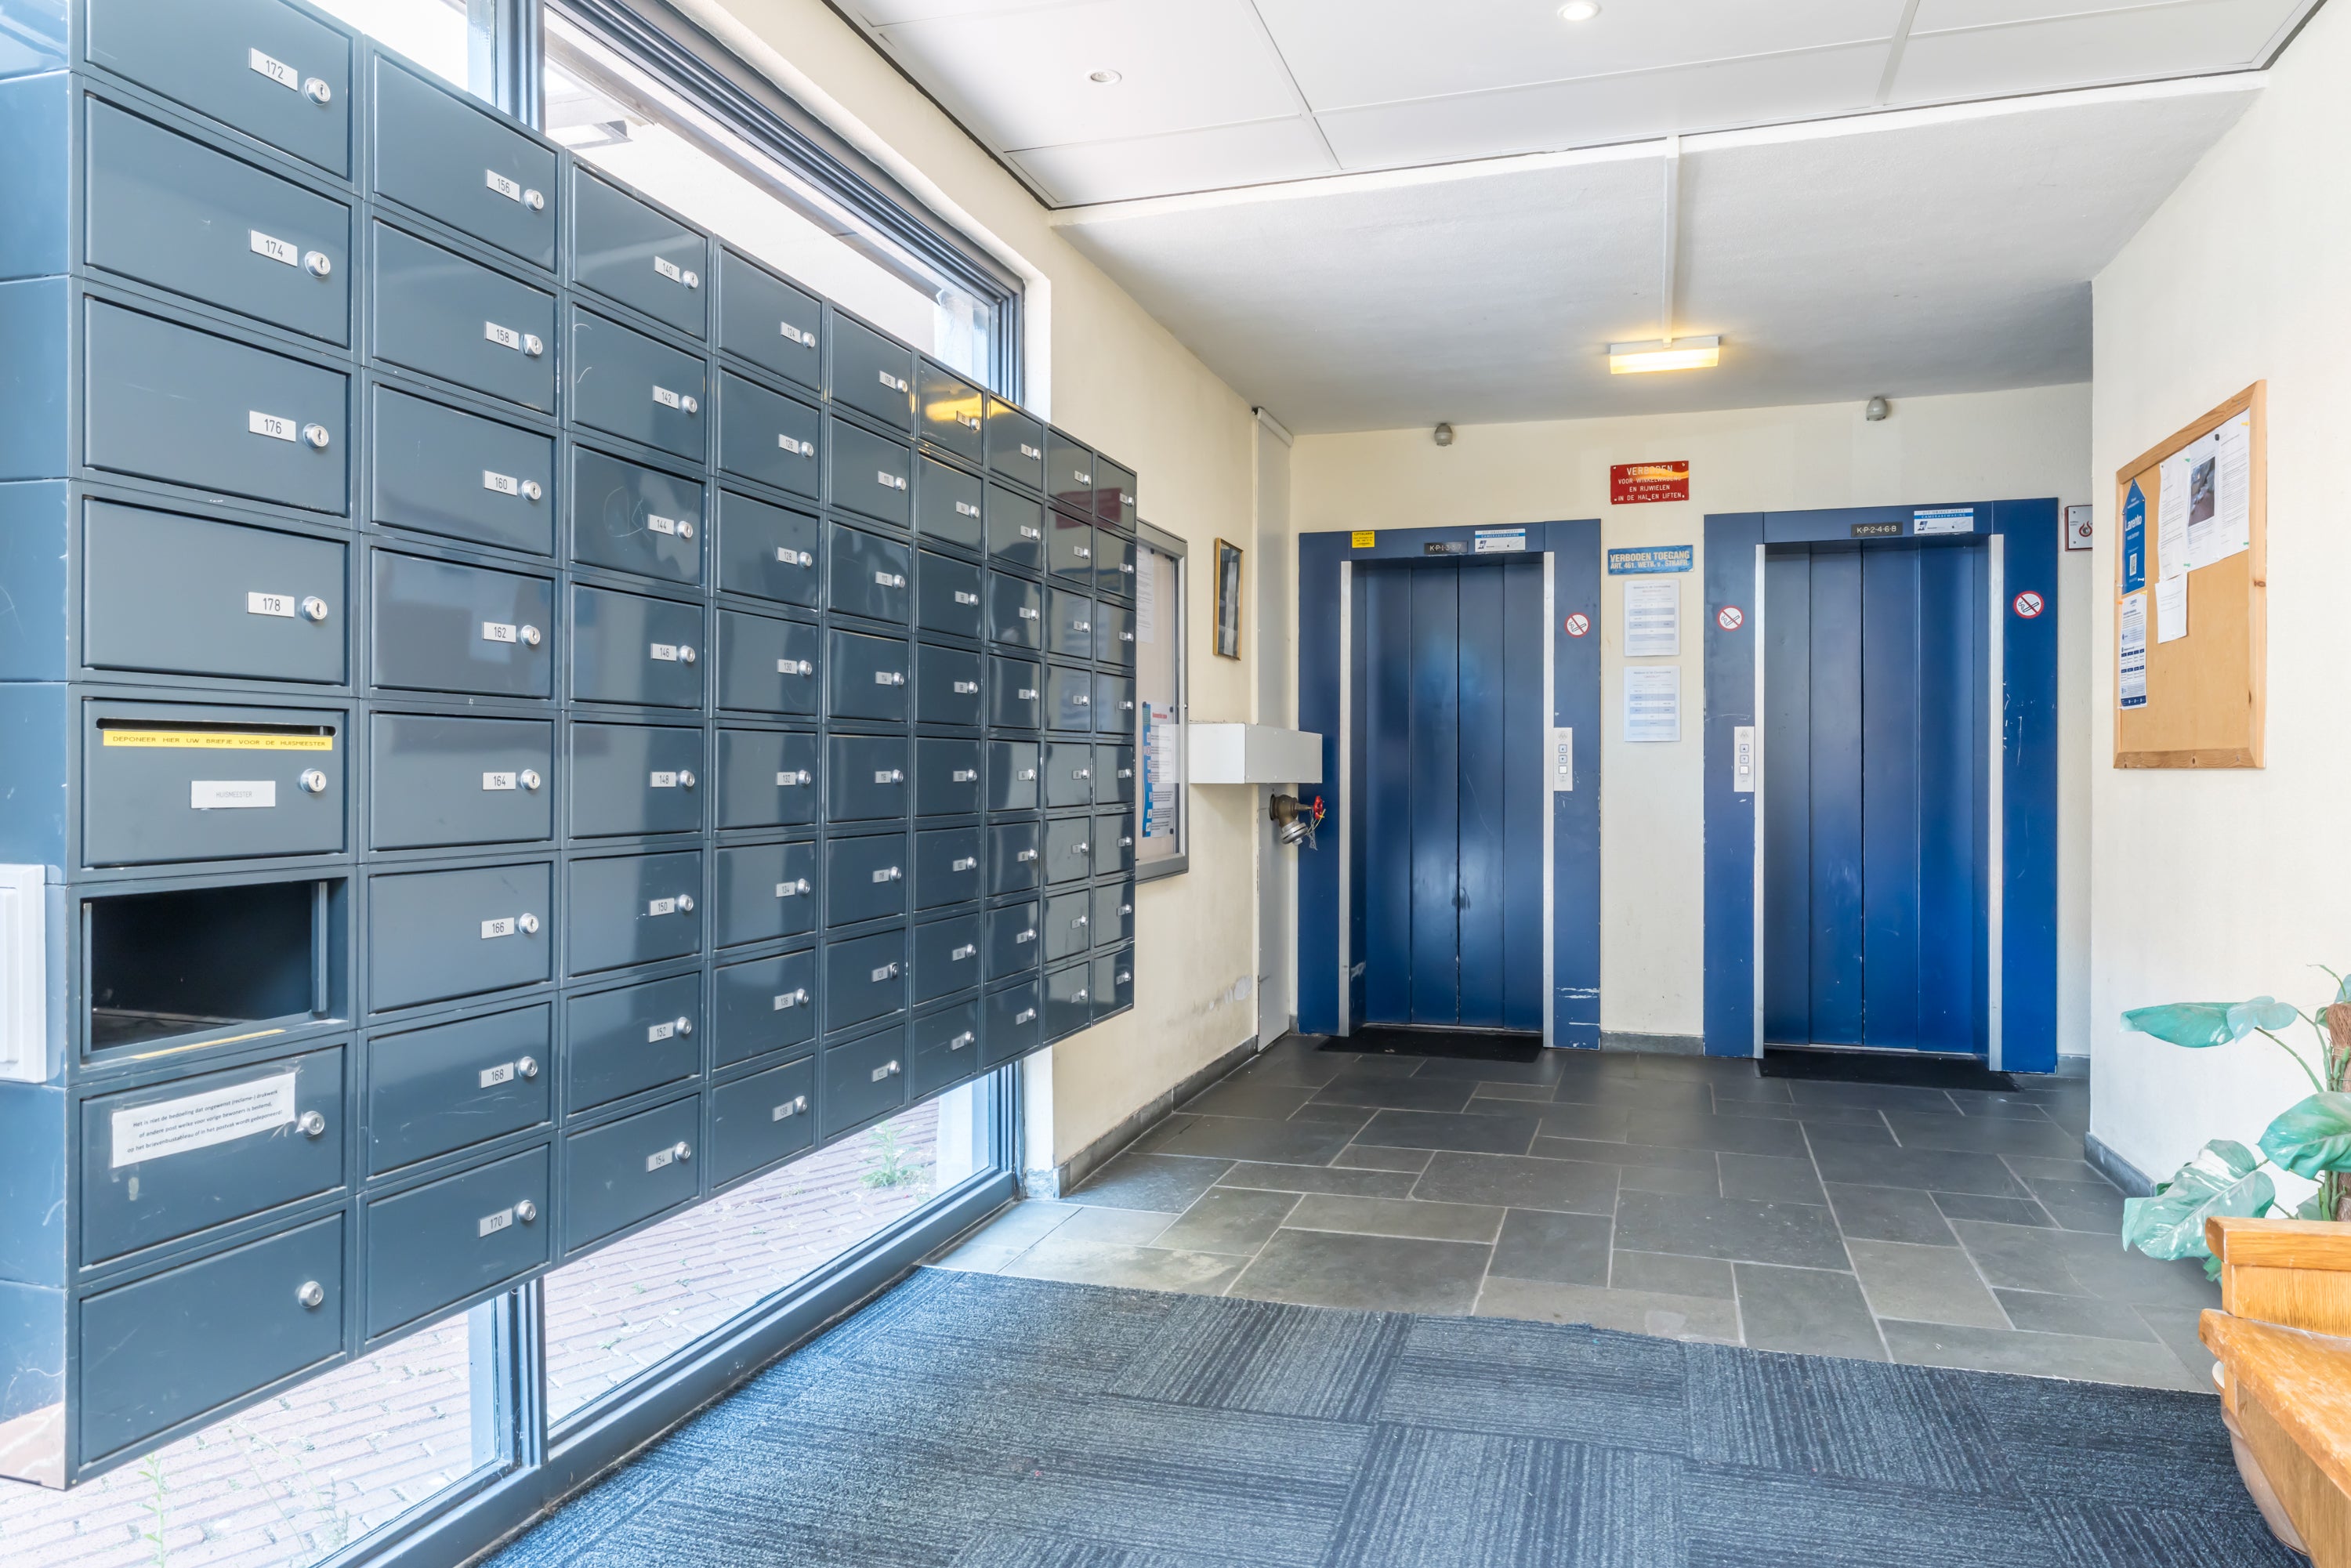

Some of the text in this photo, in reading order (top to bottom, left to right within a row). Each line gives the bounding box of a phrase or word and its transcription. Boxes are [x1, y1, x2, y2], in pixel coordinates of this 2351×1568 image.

[266, 60, 284, 79] 172
[497, 178, 509, 194] 156
[266, 240, 283, 257] 174
[662, 263, 672, 276] 140
[496, 328, 509, 342] 158
[661, 391, 672, 404] 142
[264, 418, 281, 434] 176
[494, 476, 507, 490] 160
[657, 520, 666, 529] 144
[2125, 514, 2143, 531] Larento
[1610, 551, 1690, 563] VERBODEN TOEGANG
[263, 598, 281, 611] 178
[494, 626, 506, 639] 162
[659, 647, 669, 657] 146
[493, 776, 506, 786] 164
[659, 775, 668, 784] 148
[657, 902, 668, 912] 150
[492, 922, 505, 934] 166
[657, 1027, 666, 1037] 152
[491, 1069, 504, 1081] 168
[168, 1110, 194, 1119] bedoeling
[205, 1101, 230, 1111] ongewenst
[256, 1090, 277, 1099] drukwerk
[146, 1128, 164, 1137] andere
[223, 1109, 245, 1118] bewoners
[146, 1133, 194, 1148] brievenbustableau
[216, 1122, 234, 1132] postvak
[655, 1153, 665, 1164] 154
[490, 1215, 502, 1229] 170
